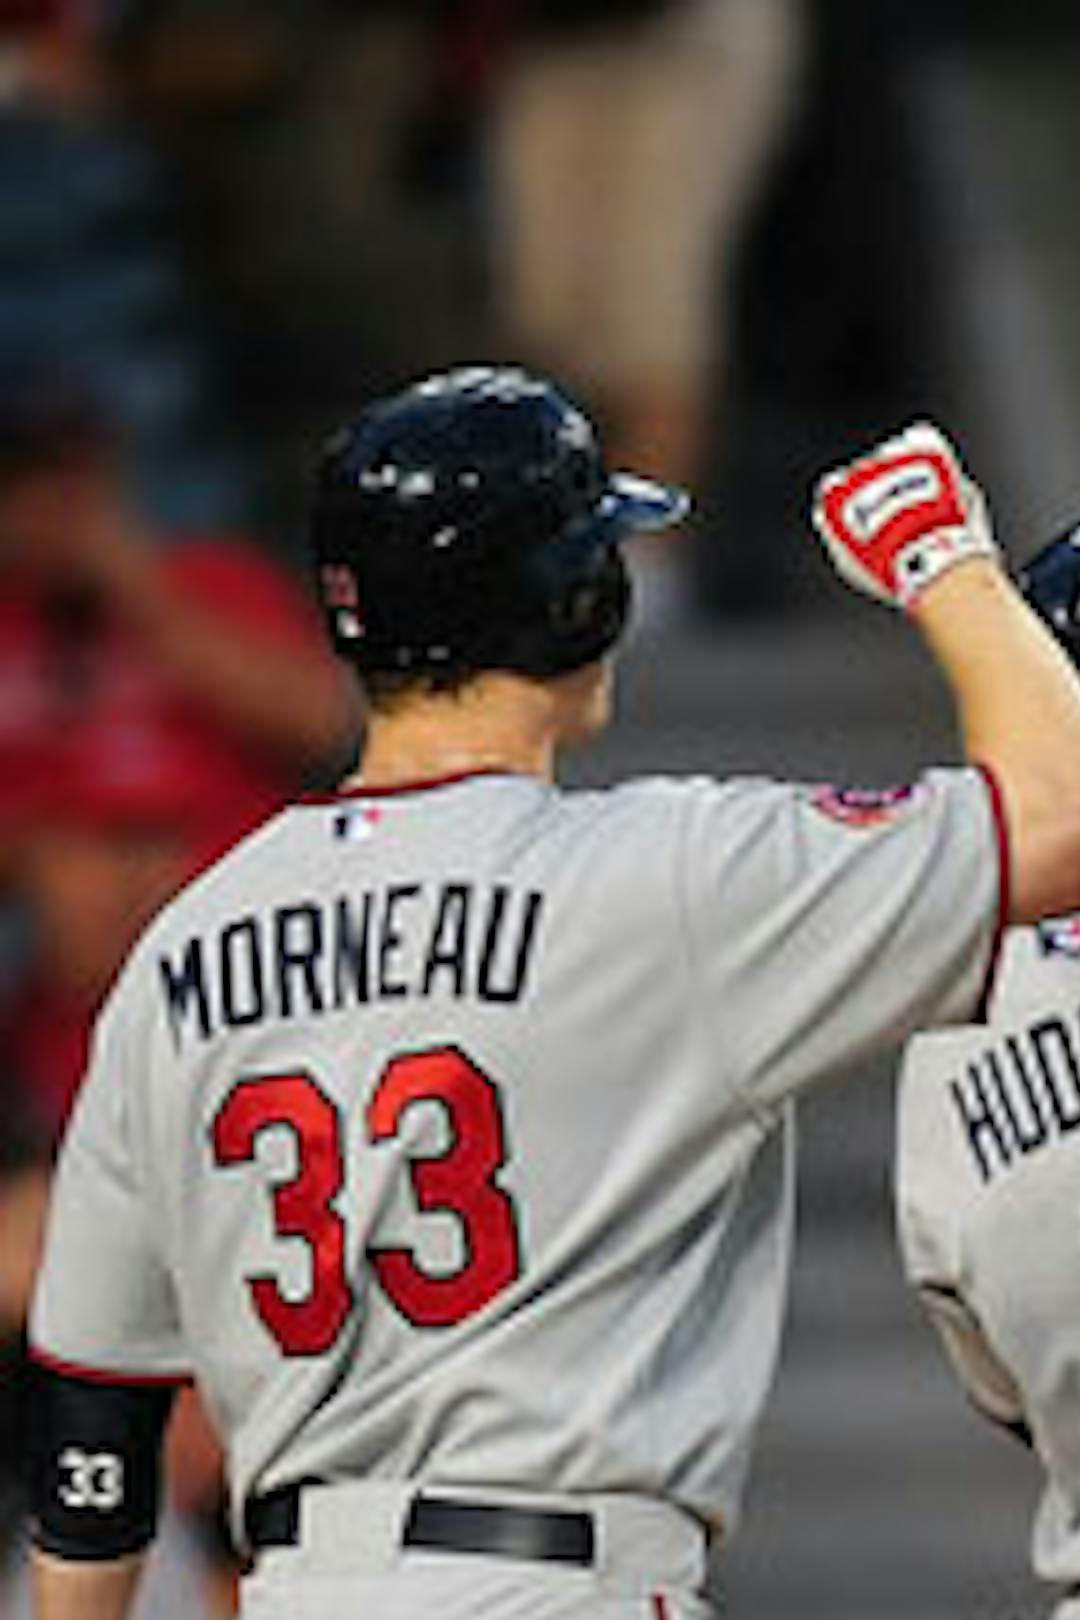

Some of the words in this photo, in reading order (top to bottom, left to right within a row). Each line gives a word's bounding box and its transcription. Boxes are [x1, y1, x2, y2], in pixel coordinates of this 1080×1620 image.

[157, 881, 546, 1053] MORNEAU
[210, 1043, 525, 1358] 33
[56, 1446, 125, 1508] 33
